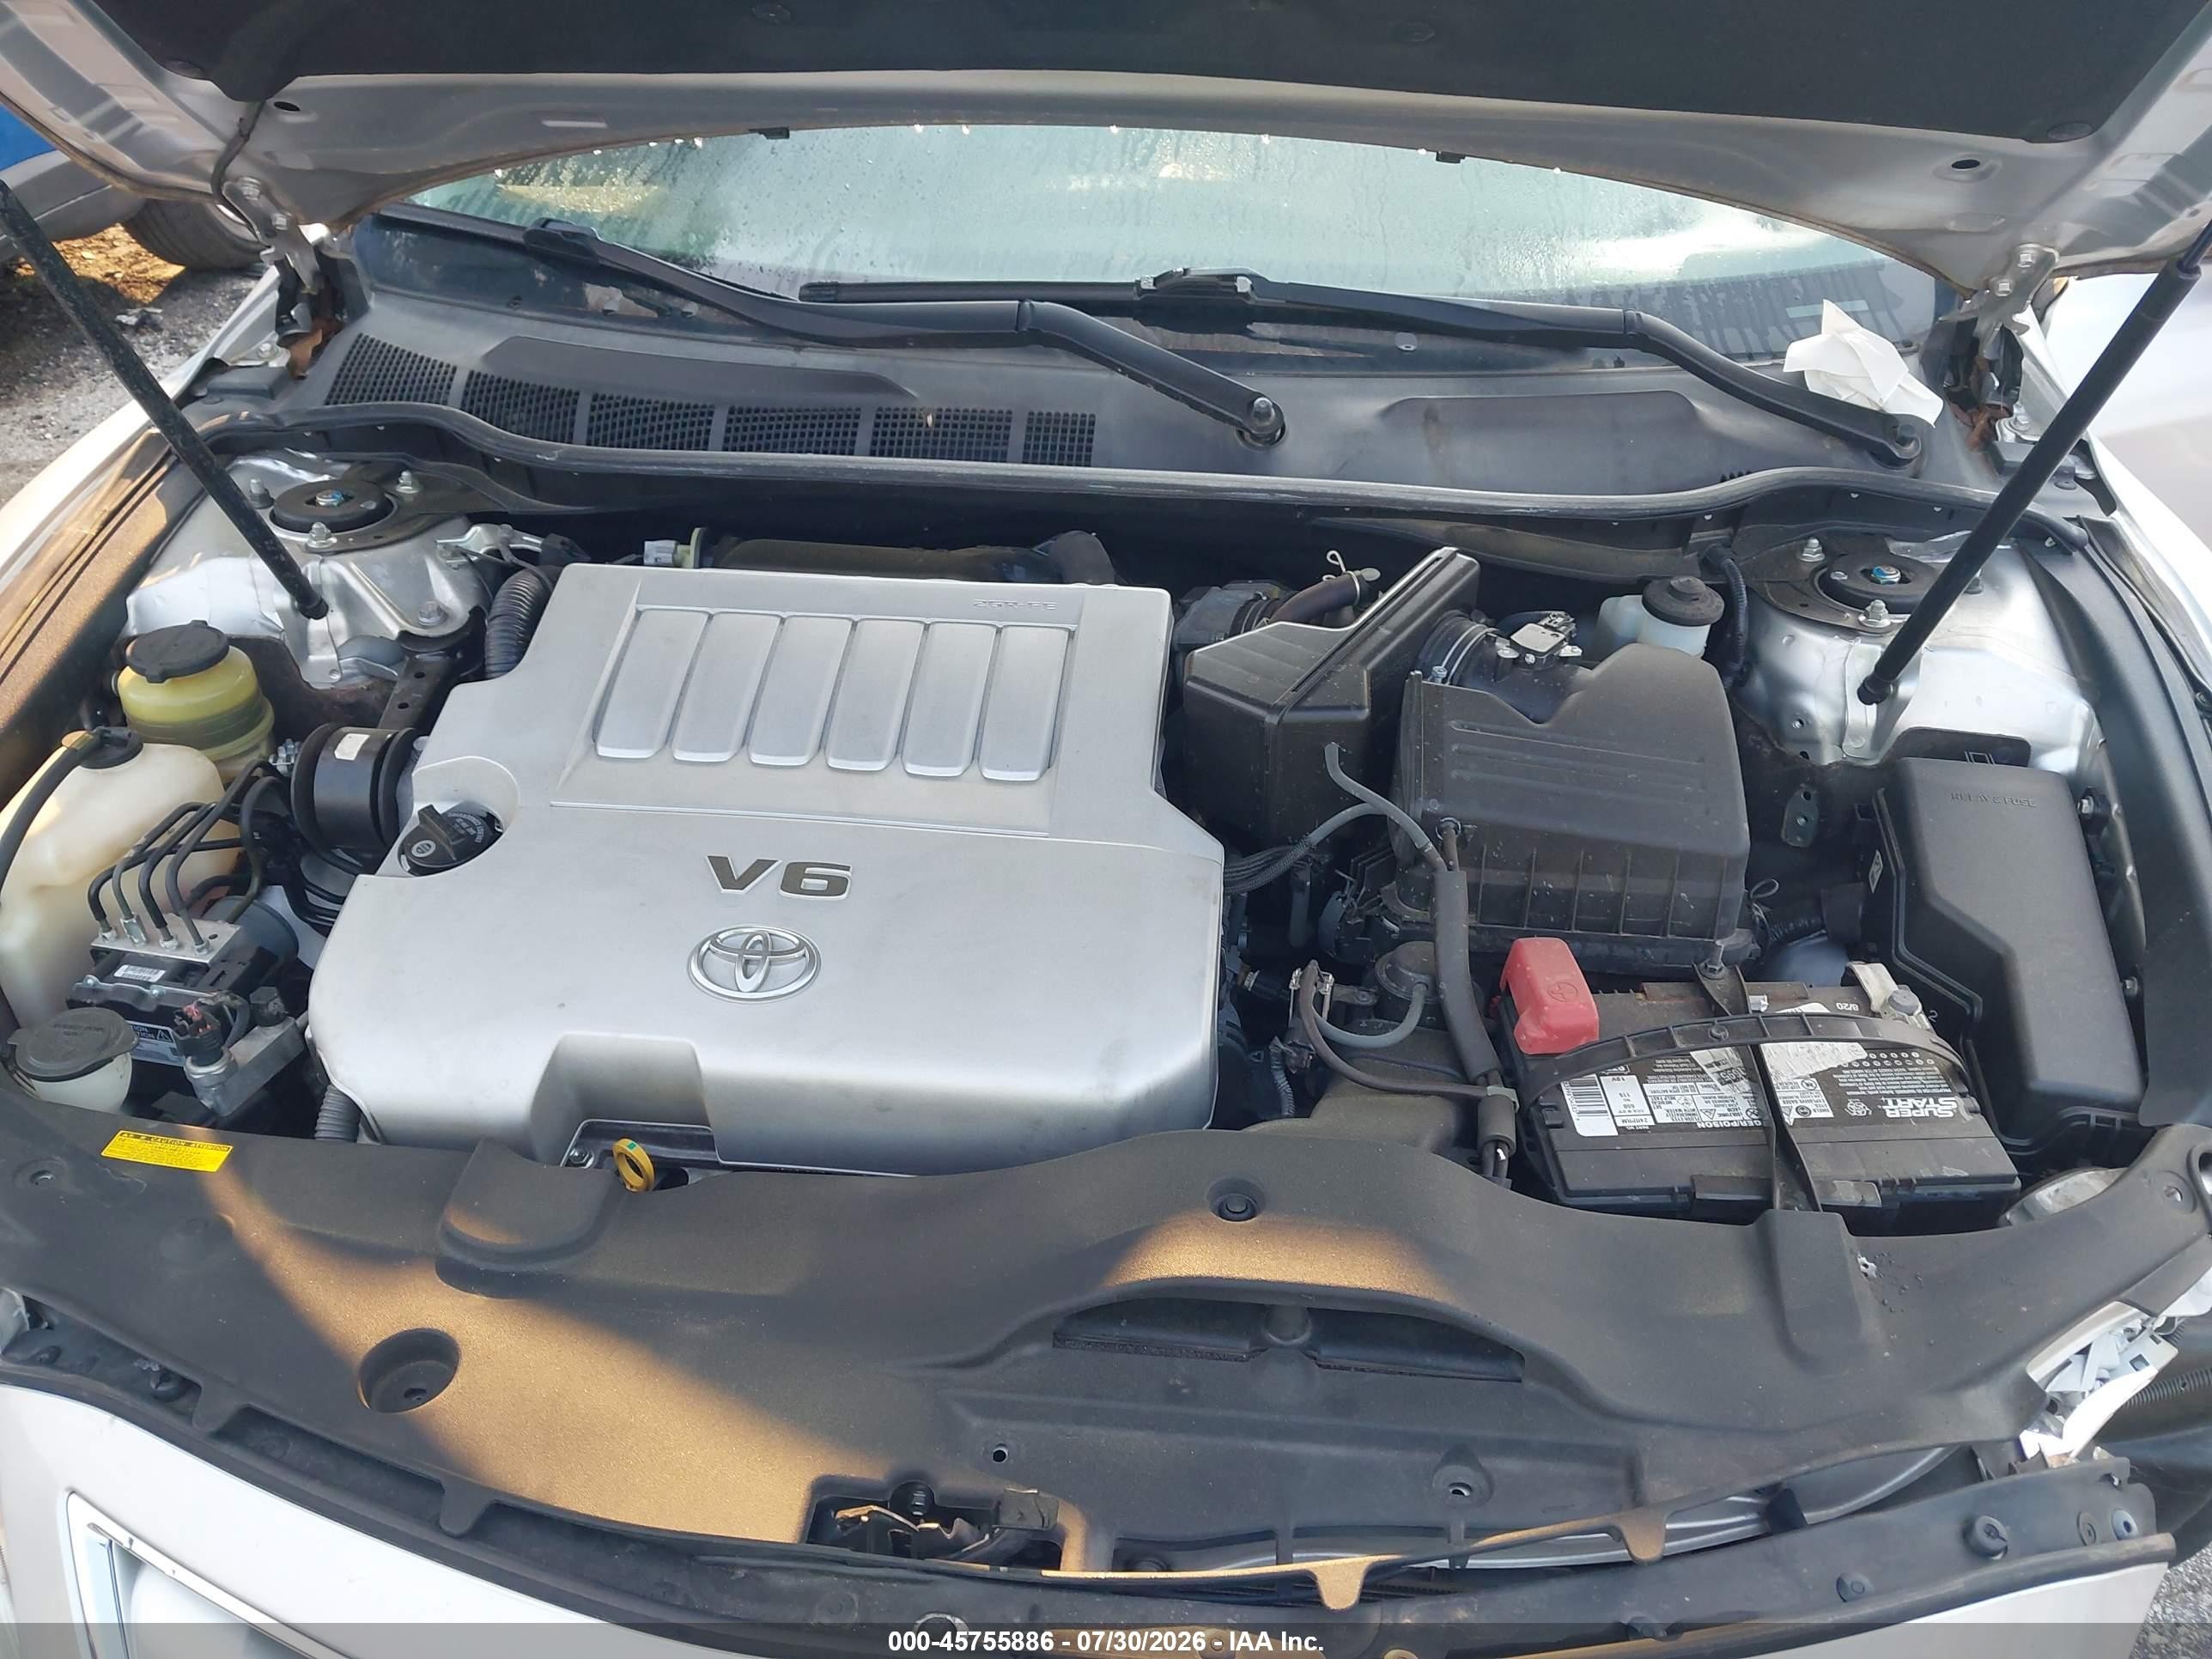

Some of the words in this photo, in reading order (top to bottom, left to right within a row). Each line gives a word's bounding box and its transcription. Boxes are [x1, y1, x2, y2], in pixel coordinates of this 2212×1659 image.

[2002, 796, 2036, 808] FUSE
[706, 854, 852, 900] V6
[1881, 1097, 1958, 1109] START
[1884, 1108, 1954, 1118] SUPER
[150, 1136, 186, 1146] CAUTION
